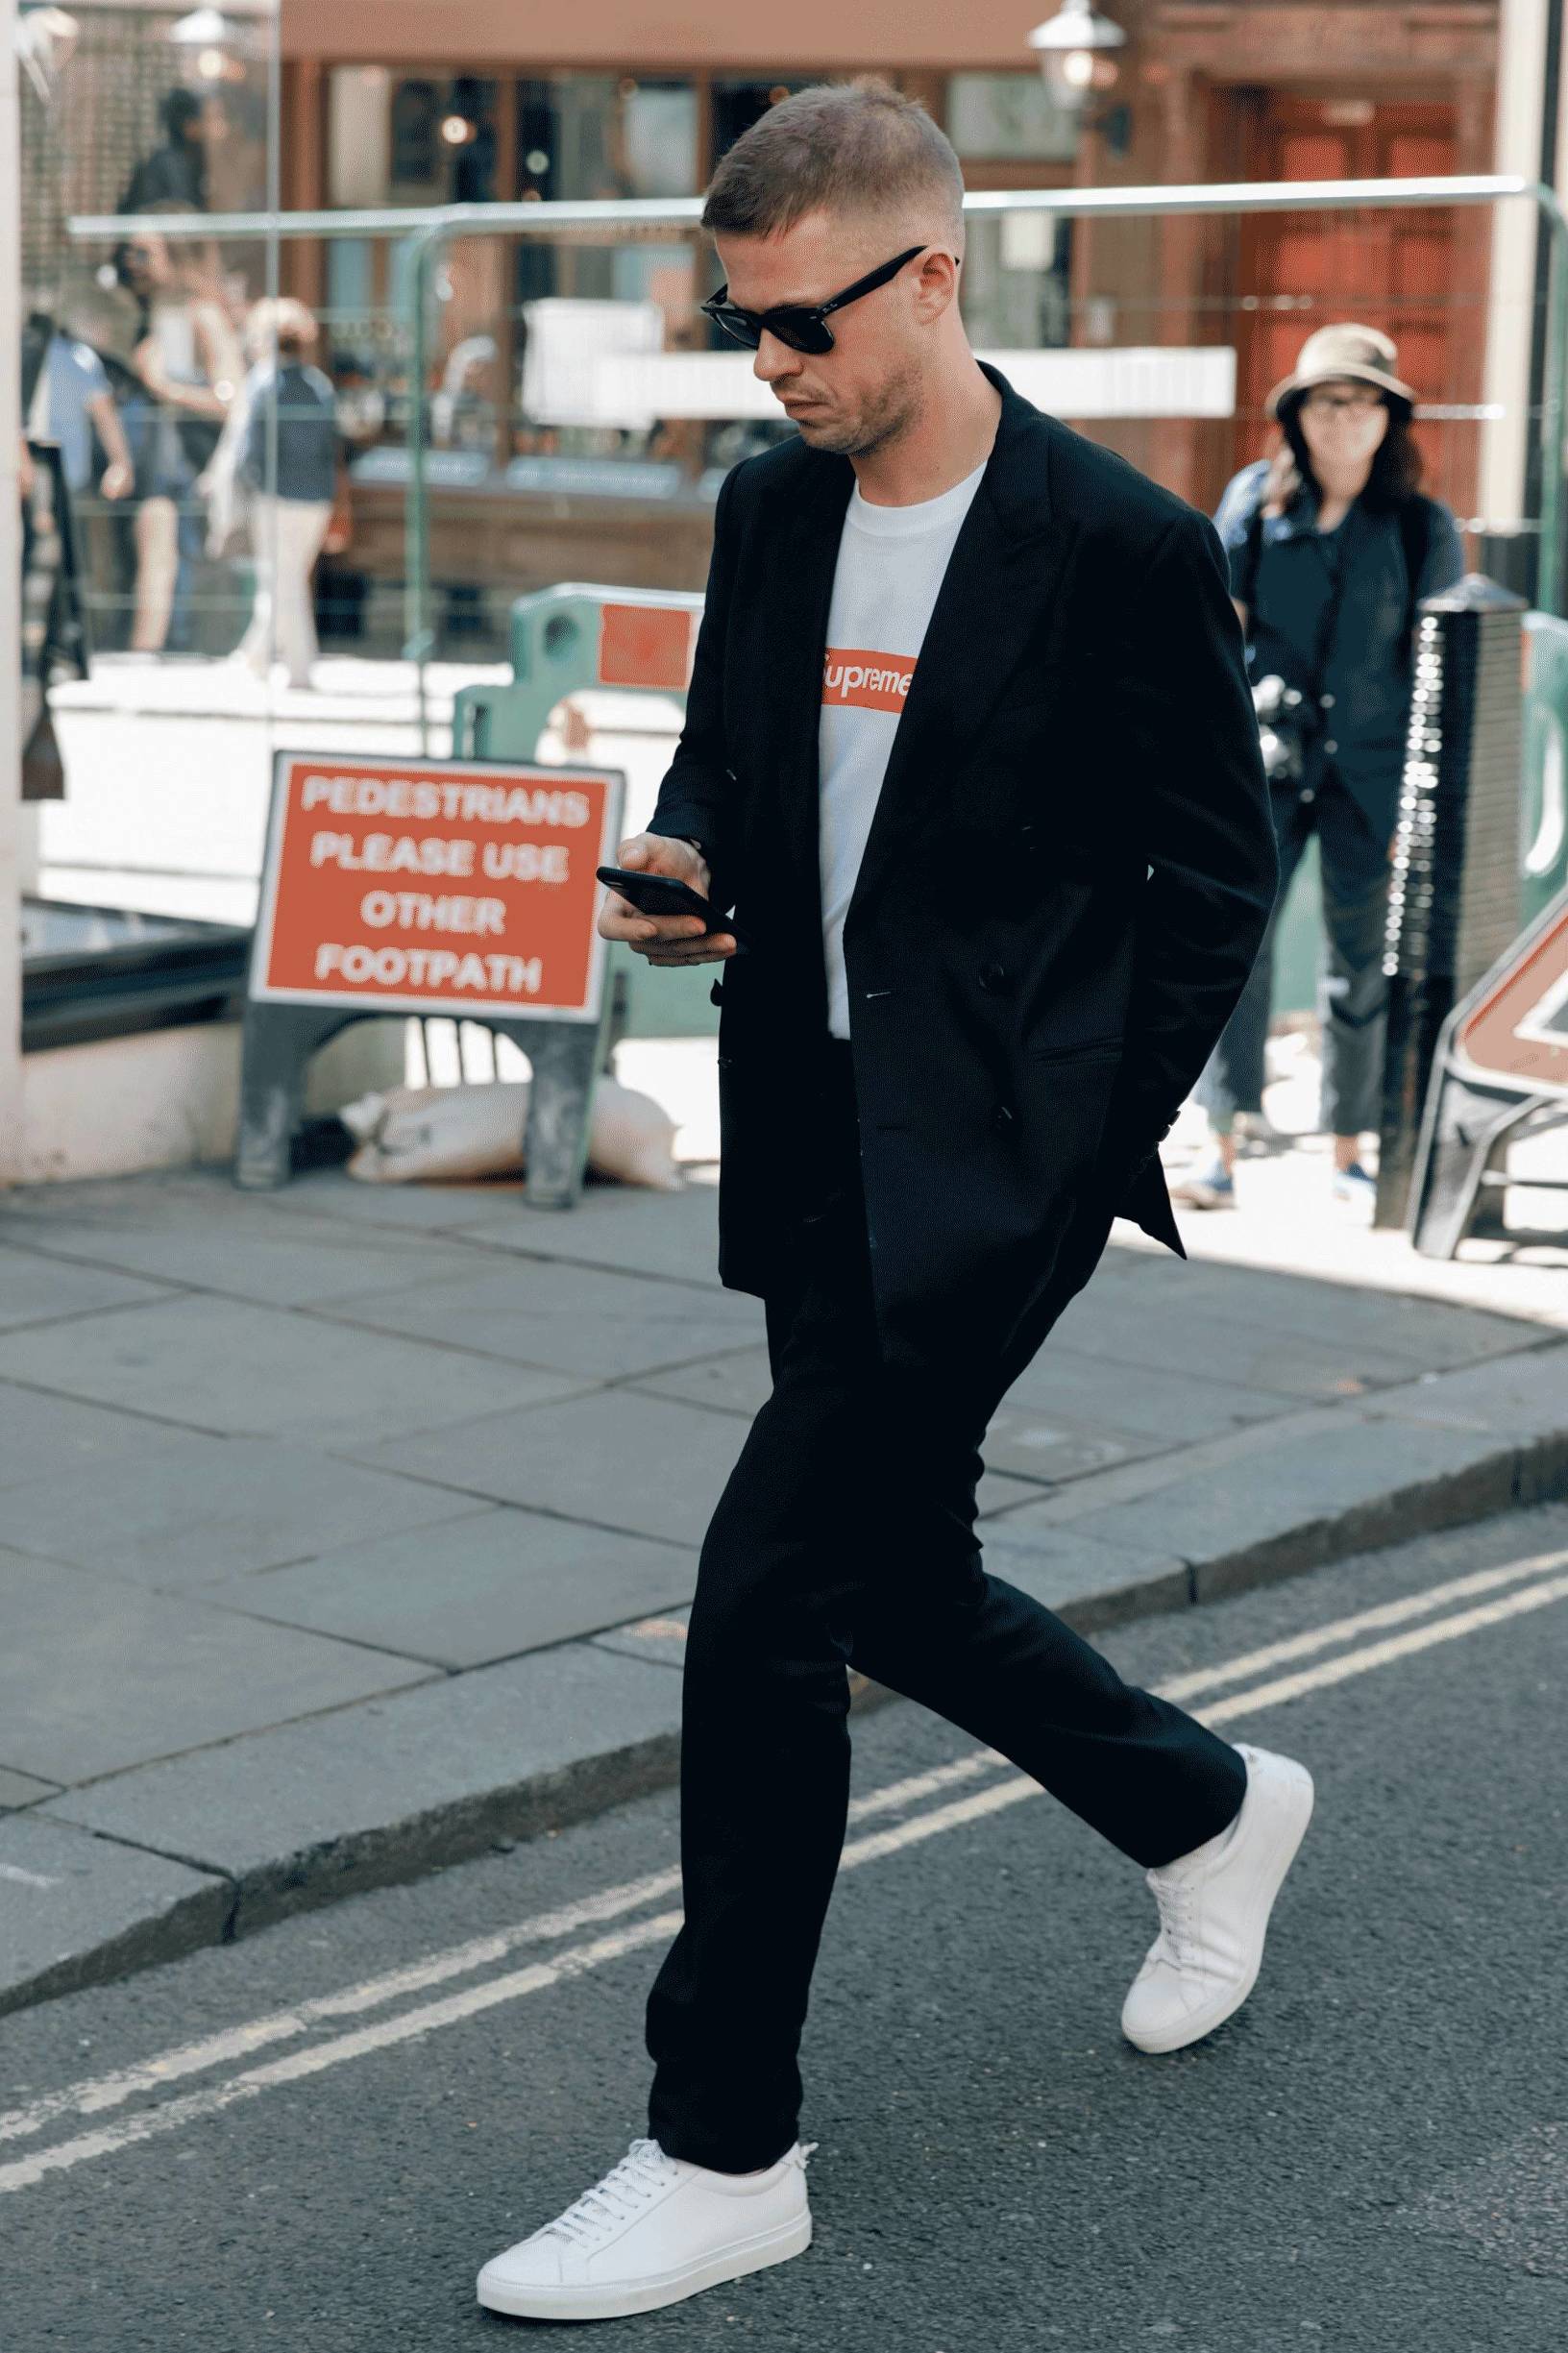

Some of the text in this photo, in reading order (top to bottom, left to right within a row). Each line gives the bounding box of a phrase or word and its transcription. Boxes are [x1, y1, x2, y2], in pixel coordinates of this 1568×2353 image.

[823, 653, 914, 699] upreme
[303, 775, 590, 827] PEDESTRIANS
[311, 831, 569, 883] PLEASE USE
[360, 890, 506, 936] OTHER
[315, 943, 543, 994] FOOTPATH
